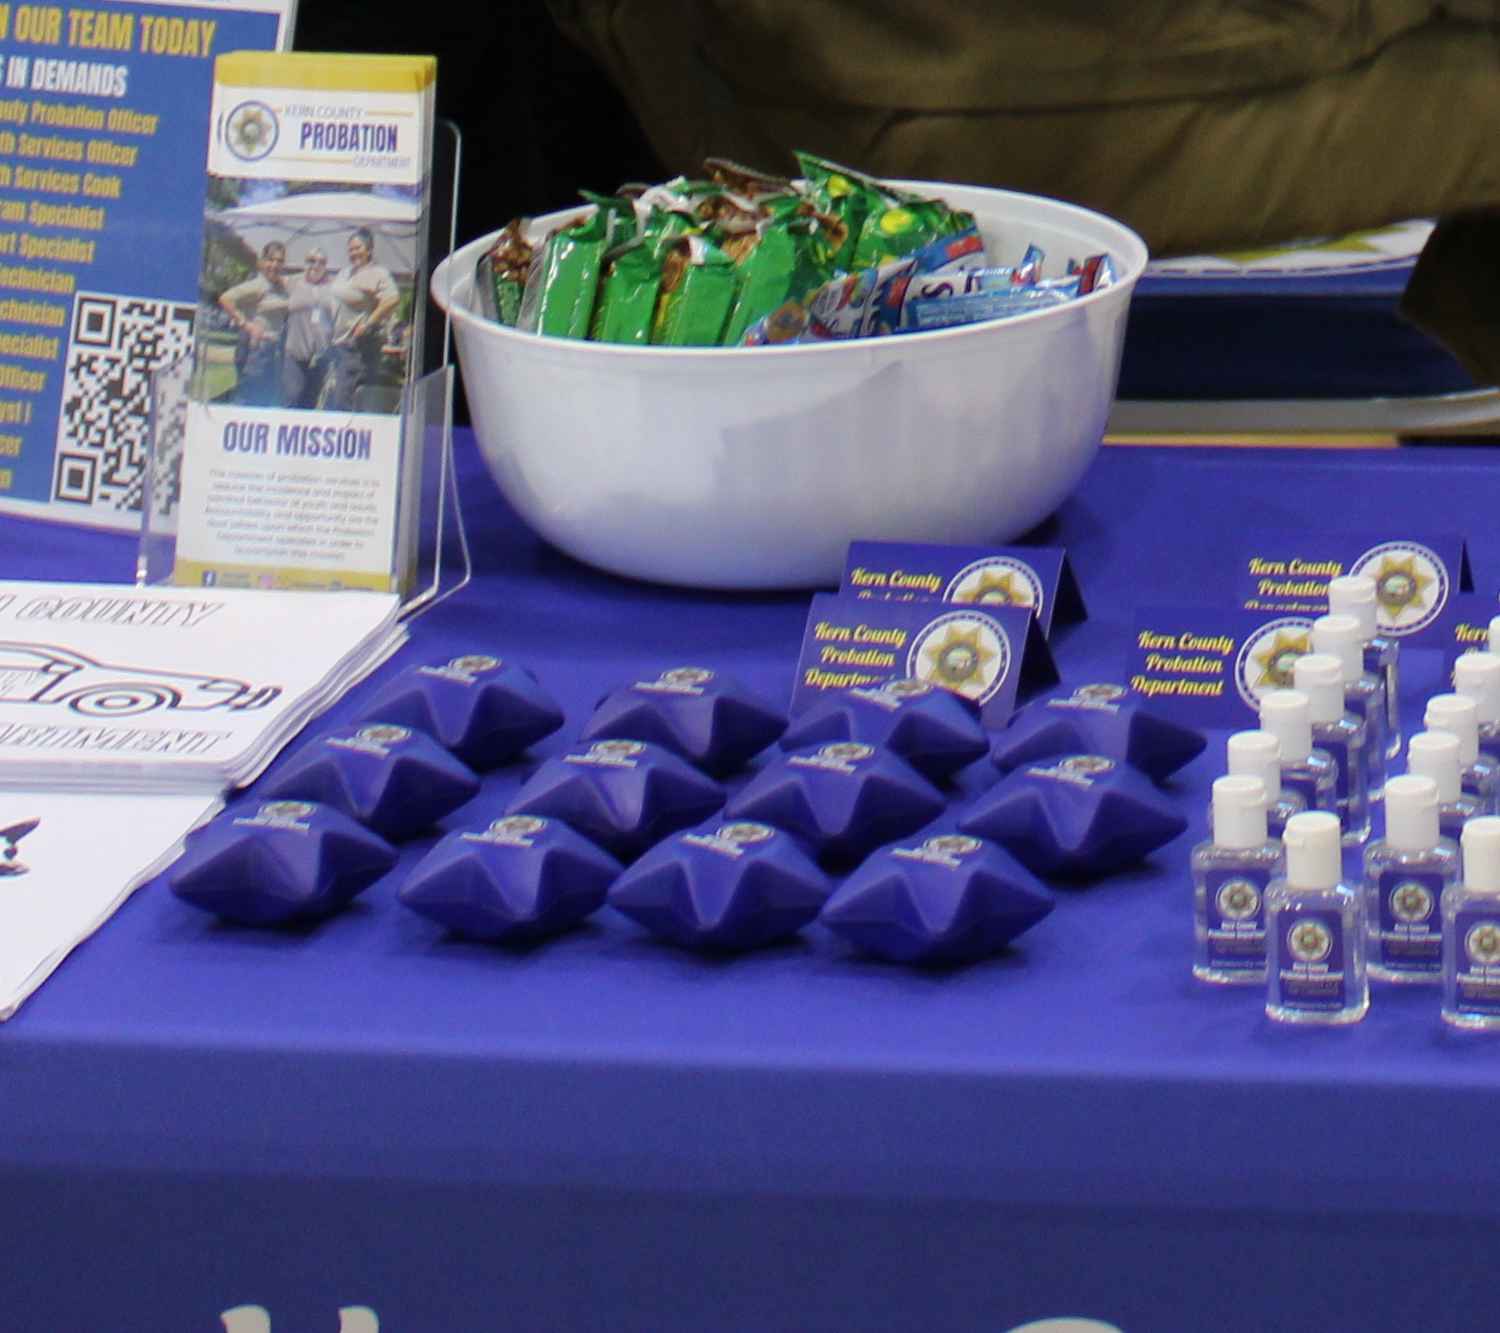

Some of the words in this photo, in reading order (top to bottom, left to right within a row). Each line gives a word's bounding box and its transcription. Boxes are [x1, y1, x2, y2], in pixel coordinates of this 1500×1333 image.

[14, 5, 62, 46] OUR
[68, 9, 134, 52] TEAM
[139, 15, 216, 58] TODAY
[6, 56, 28, 89] IN
[31, 58, 128, 98] DEMANDS
[31, 101, 105, 131] Probation
[107, 108, 160, 135] Officer
[18, 132, 84, 162] Services
[86, 140, 138, 167] Officer
[300, 121, 399, 153] PROBATION
[14, 165, 80, 195] Services
[82, 172, 122, 200] Cook
[28, 200, 105, 231] Specialist
[18, 233, 96, 264] Specialist
[222, 420, 268, 456] OUR
[277, 421, 372, 462] MISSION
[850, 567, 888, 587] Kern
[888, 569, 942, 593] County
[1248, 557, 1286, 576] Kern
[1288, 558, 1343, 580] County
[15, 595, 225, 627] COUNTY
[814, 621, 850, 642] Kern
[852, 623, 908, 649] County
[1137, 629, 1177, 650] Kern
[1177, 631, 1235, 657] County
[820, 644, 896, 668] Probation
[1145, 652, 1224, 674] Probation
[1130, 674, 1225, 698] Department
